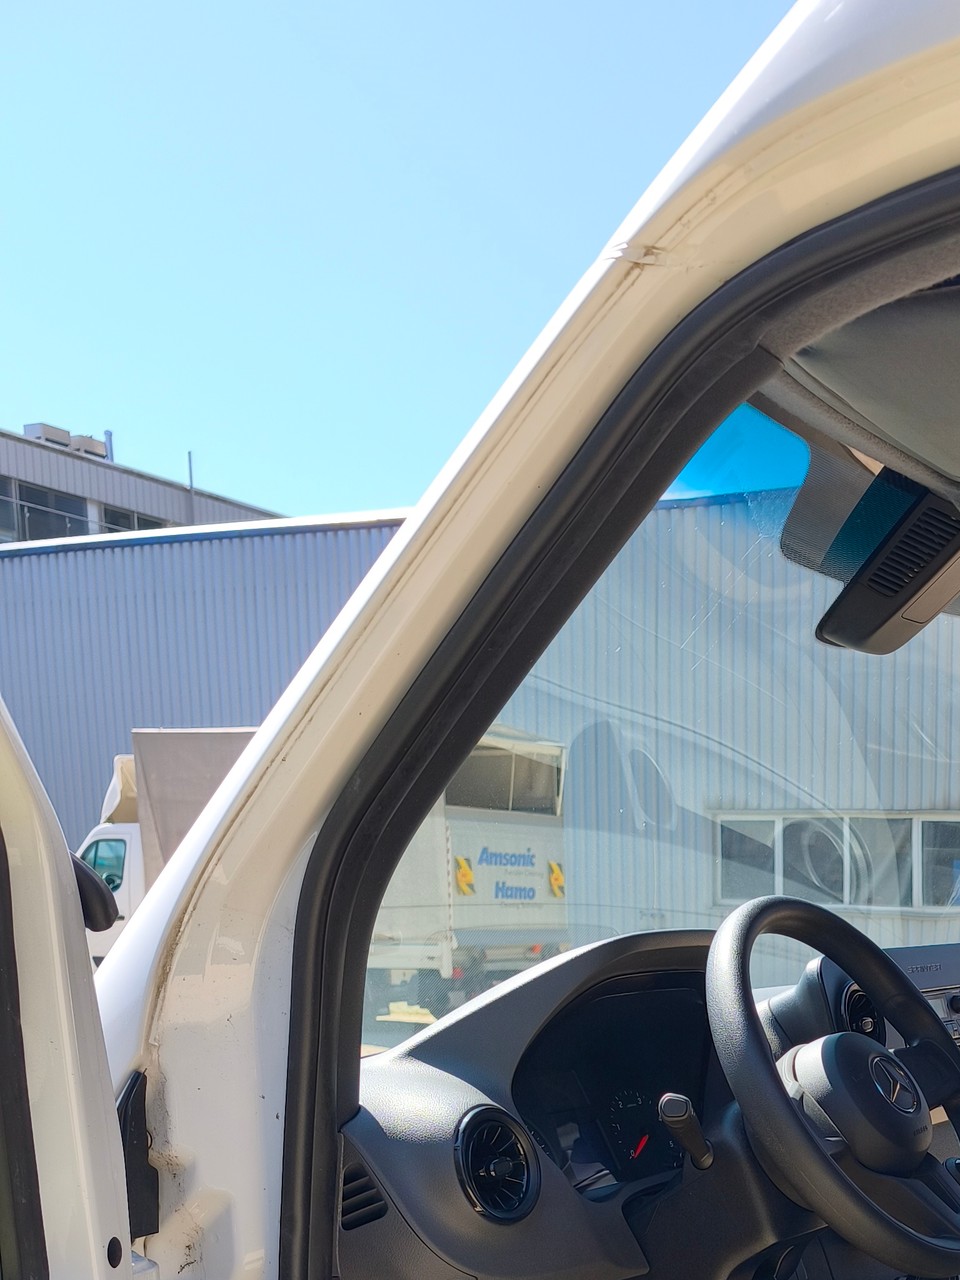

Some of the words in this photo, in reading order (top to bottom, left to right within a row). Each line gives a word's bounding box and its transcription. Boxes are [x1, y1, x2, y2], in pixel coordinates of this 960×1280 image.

[478, 846, 536, 867] Amsonic
[494, 881, 536, 900] Hamo
[907, 963, 942, 973] SPRINTER
